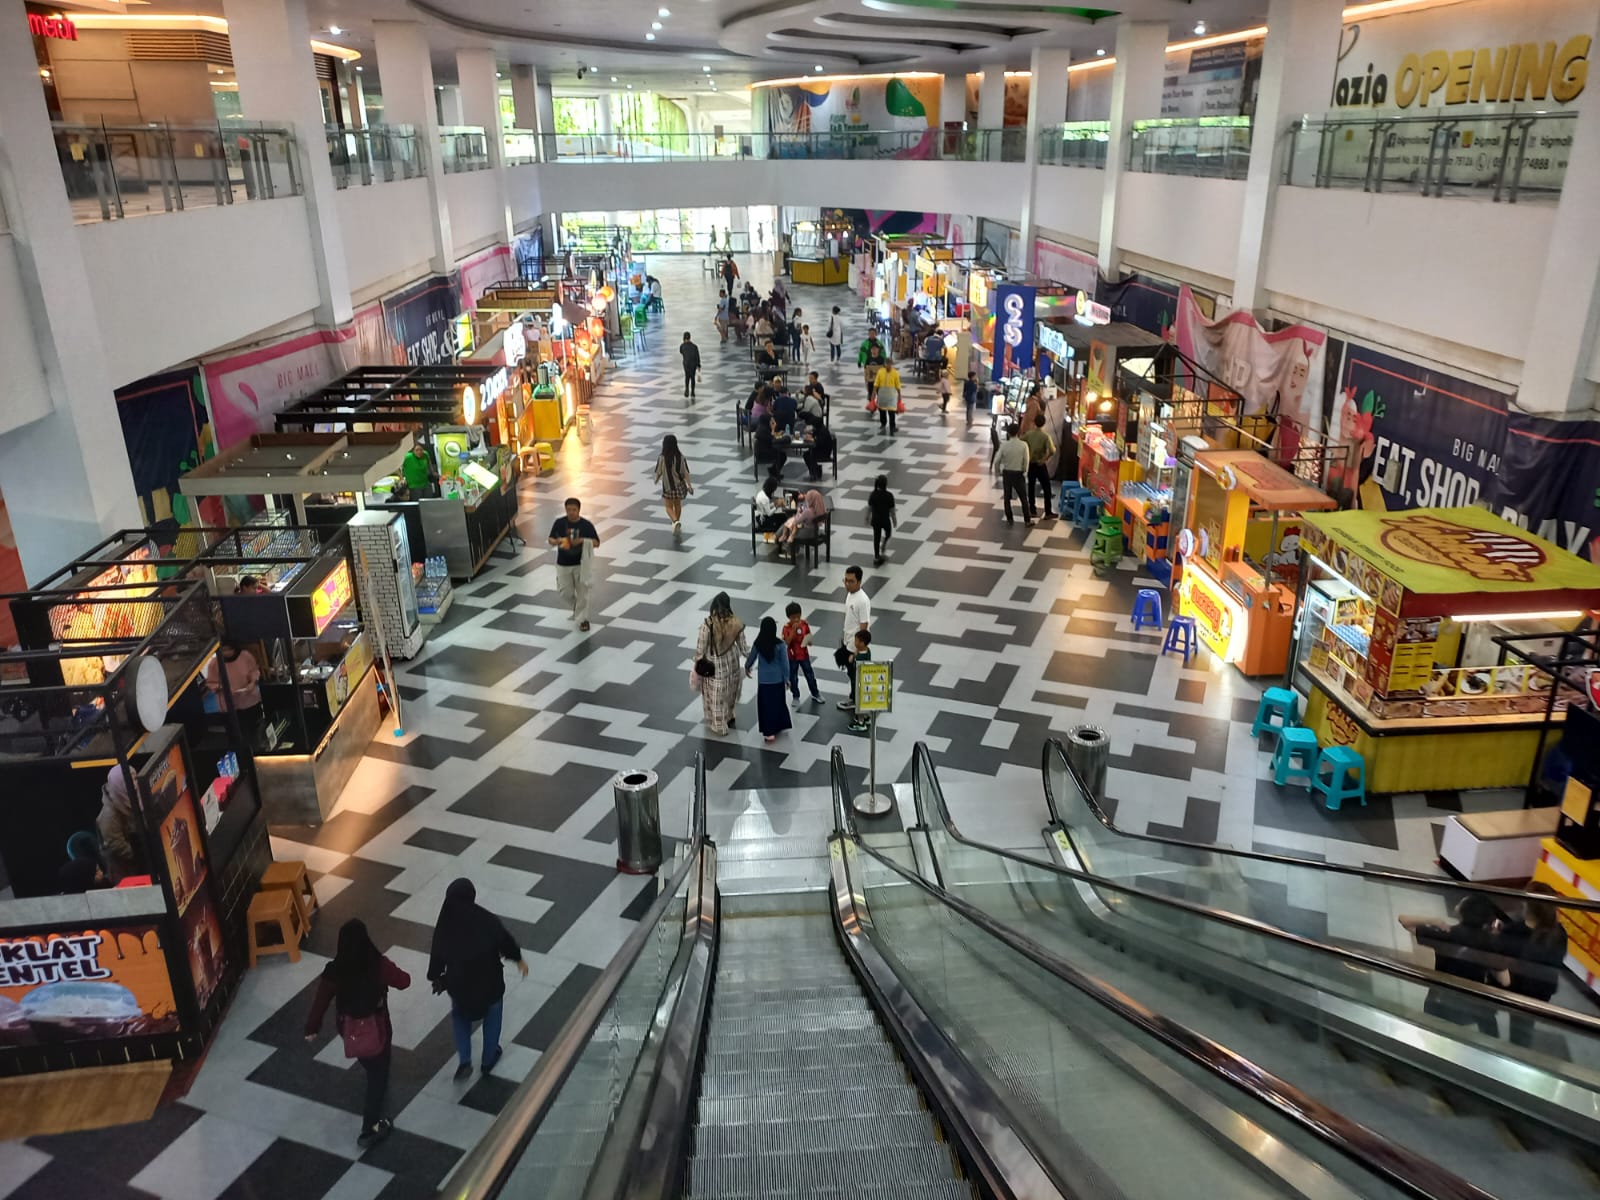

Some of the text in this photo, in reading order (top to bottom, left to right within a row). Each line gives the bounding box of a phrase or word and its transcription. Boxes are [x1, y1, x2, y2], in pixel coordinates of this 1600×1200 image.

[1394, 34, 1592, 109] OPENING
[1452, 438, 1475, 463] BIG
[0, 937, 101, 963] KLAT
